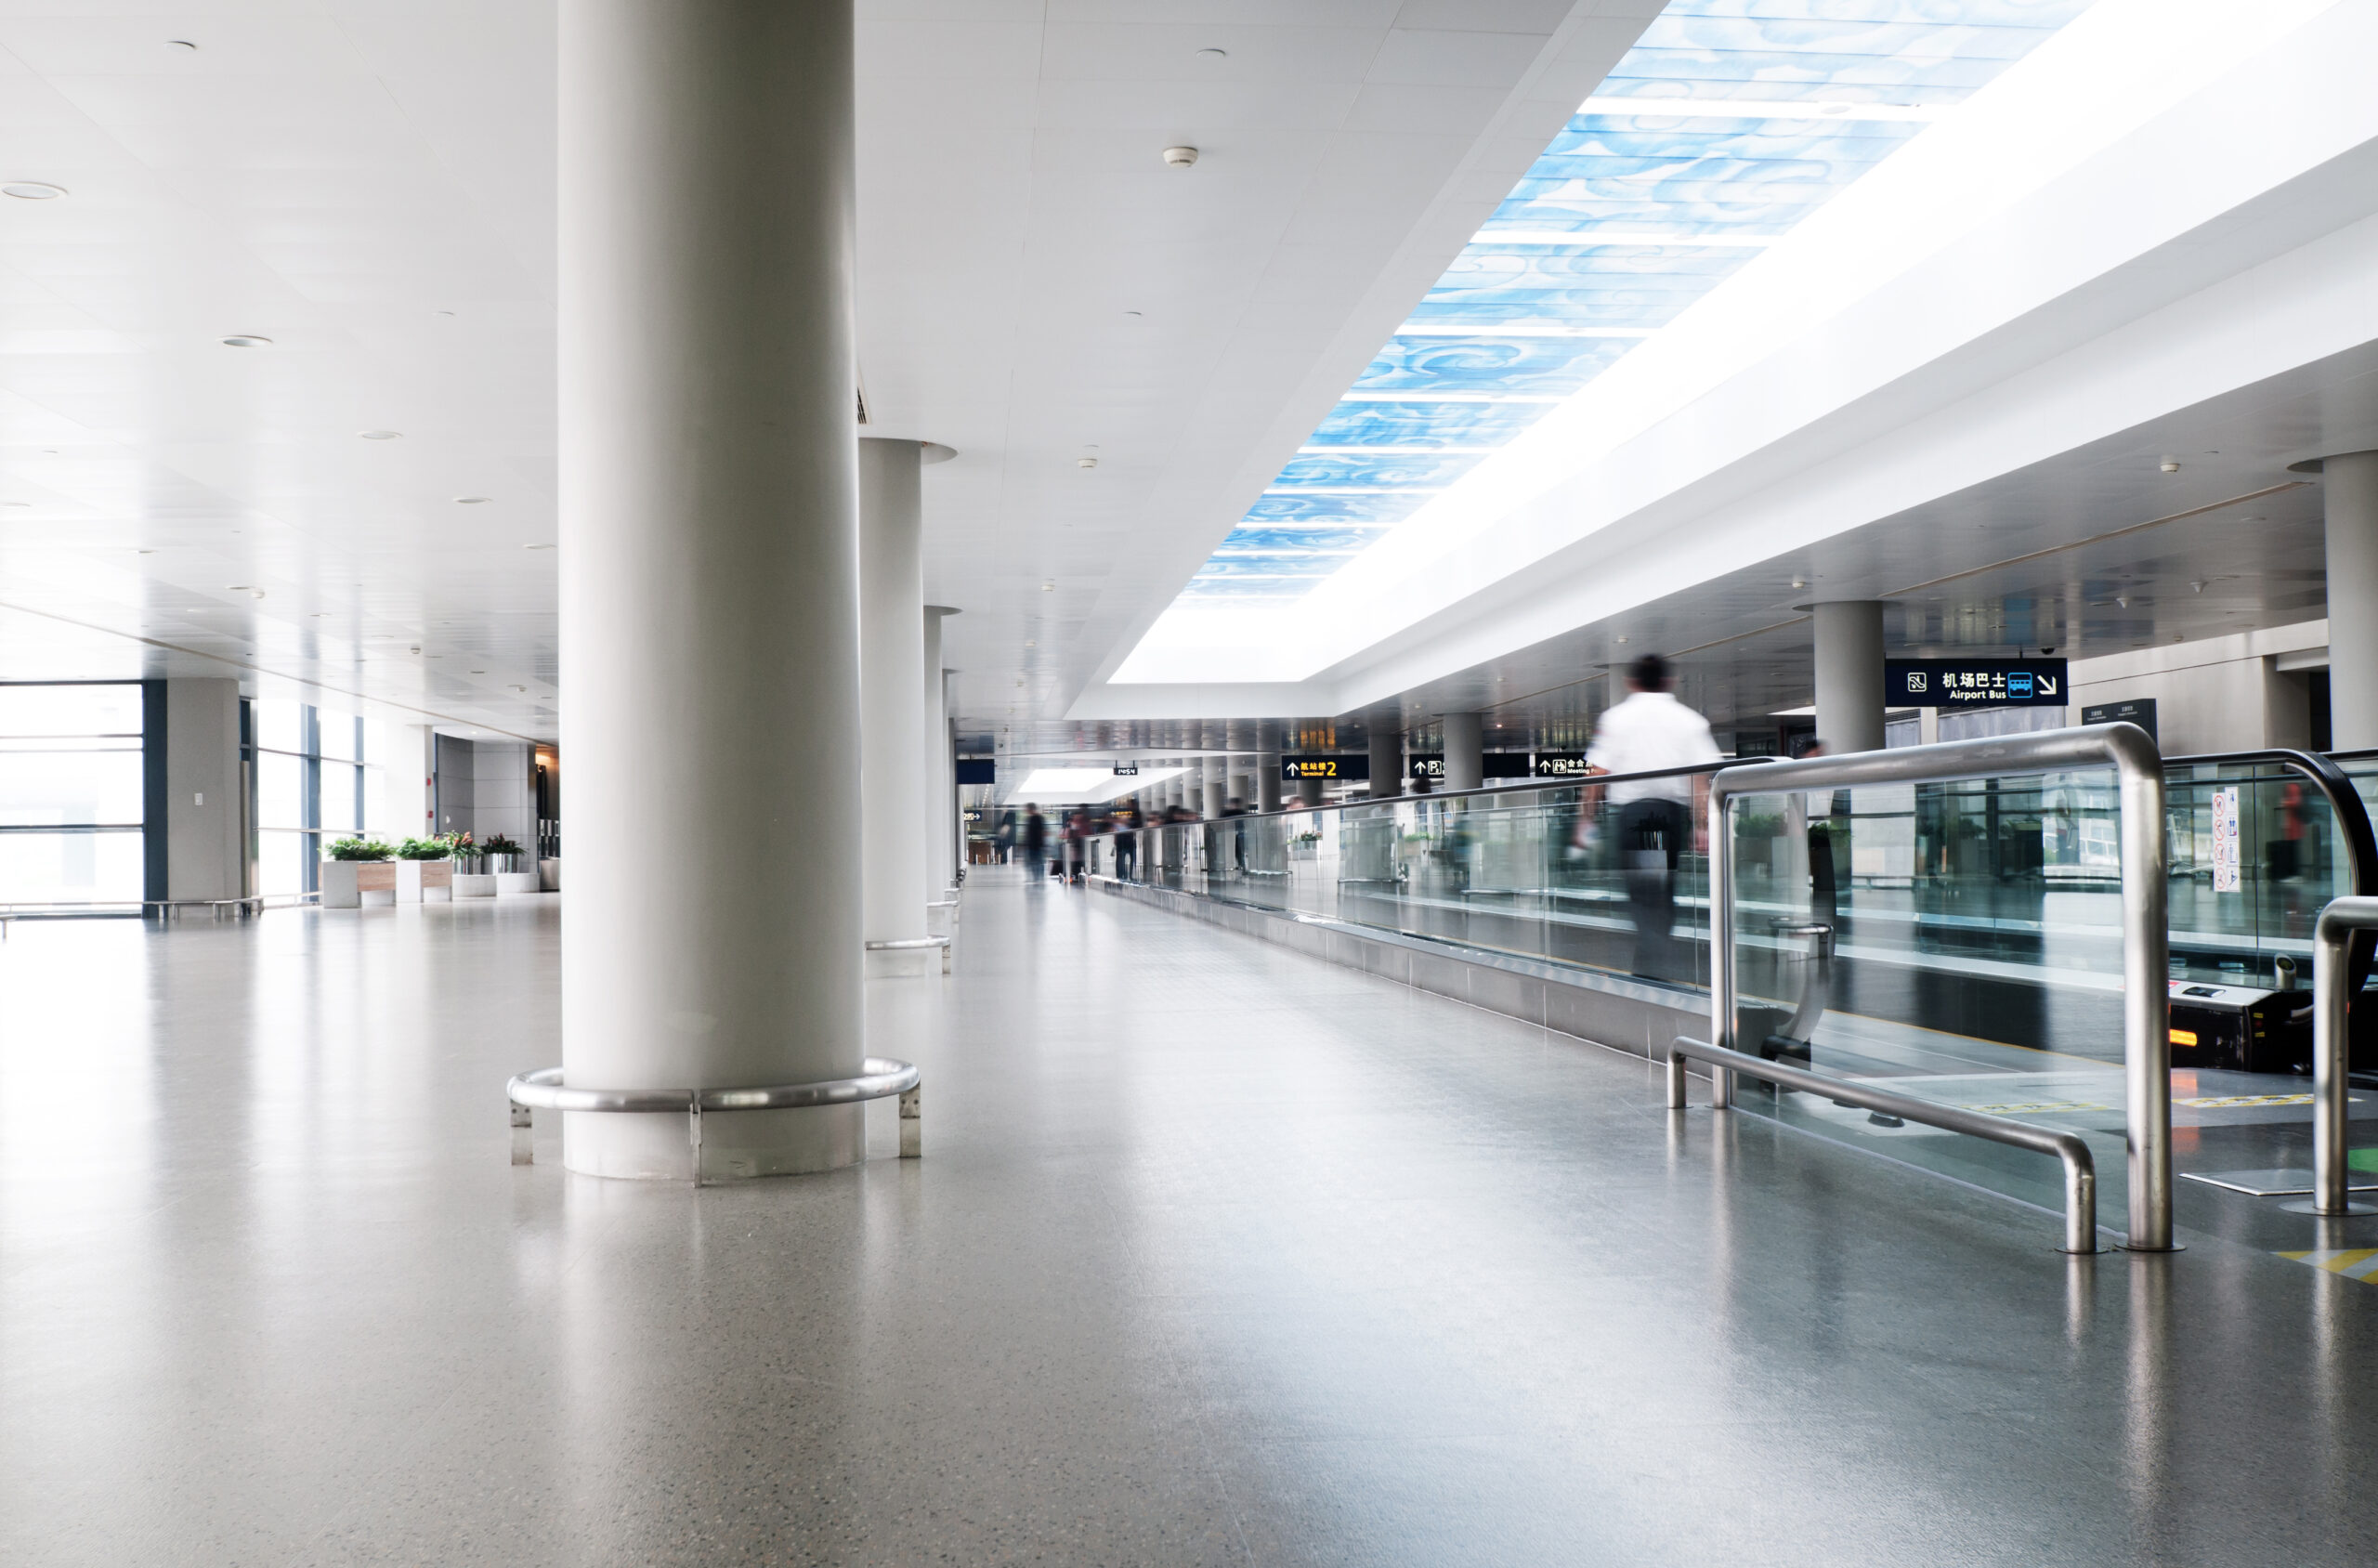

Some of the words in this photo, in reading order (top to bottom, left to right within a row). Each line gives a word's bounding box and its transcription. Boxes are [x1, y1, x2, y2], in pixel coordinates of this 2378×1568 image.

[1942, 672, 2006, 687] 机场巴士
[1950, 690, 1986, 700] Airport
[1989, 690, 2006, 699] Bus
[1326, 761, 1337, 777] 2
